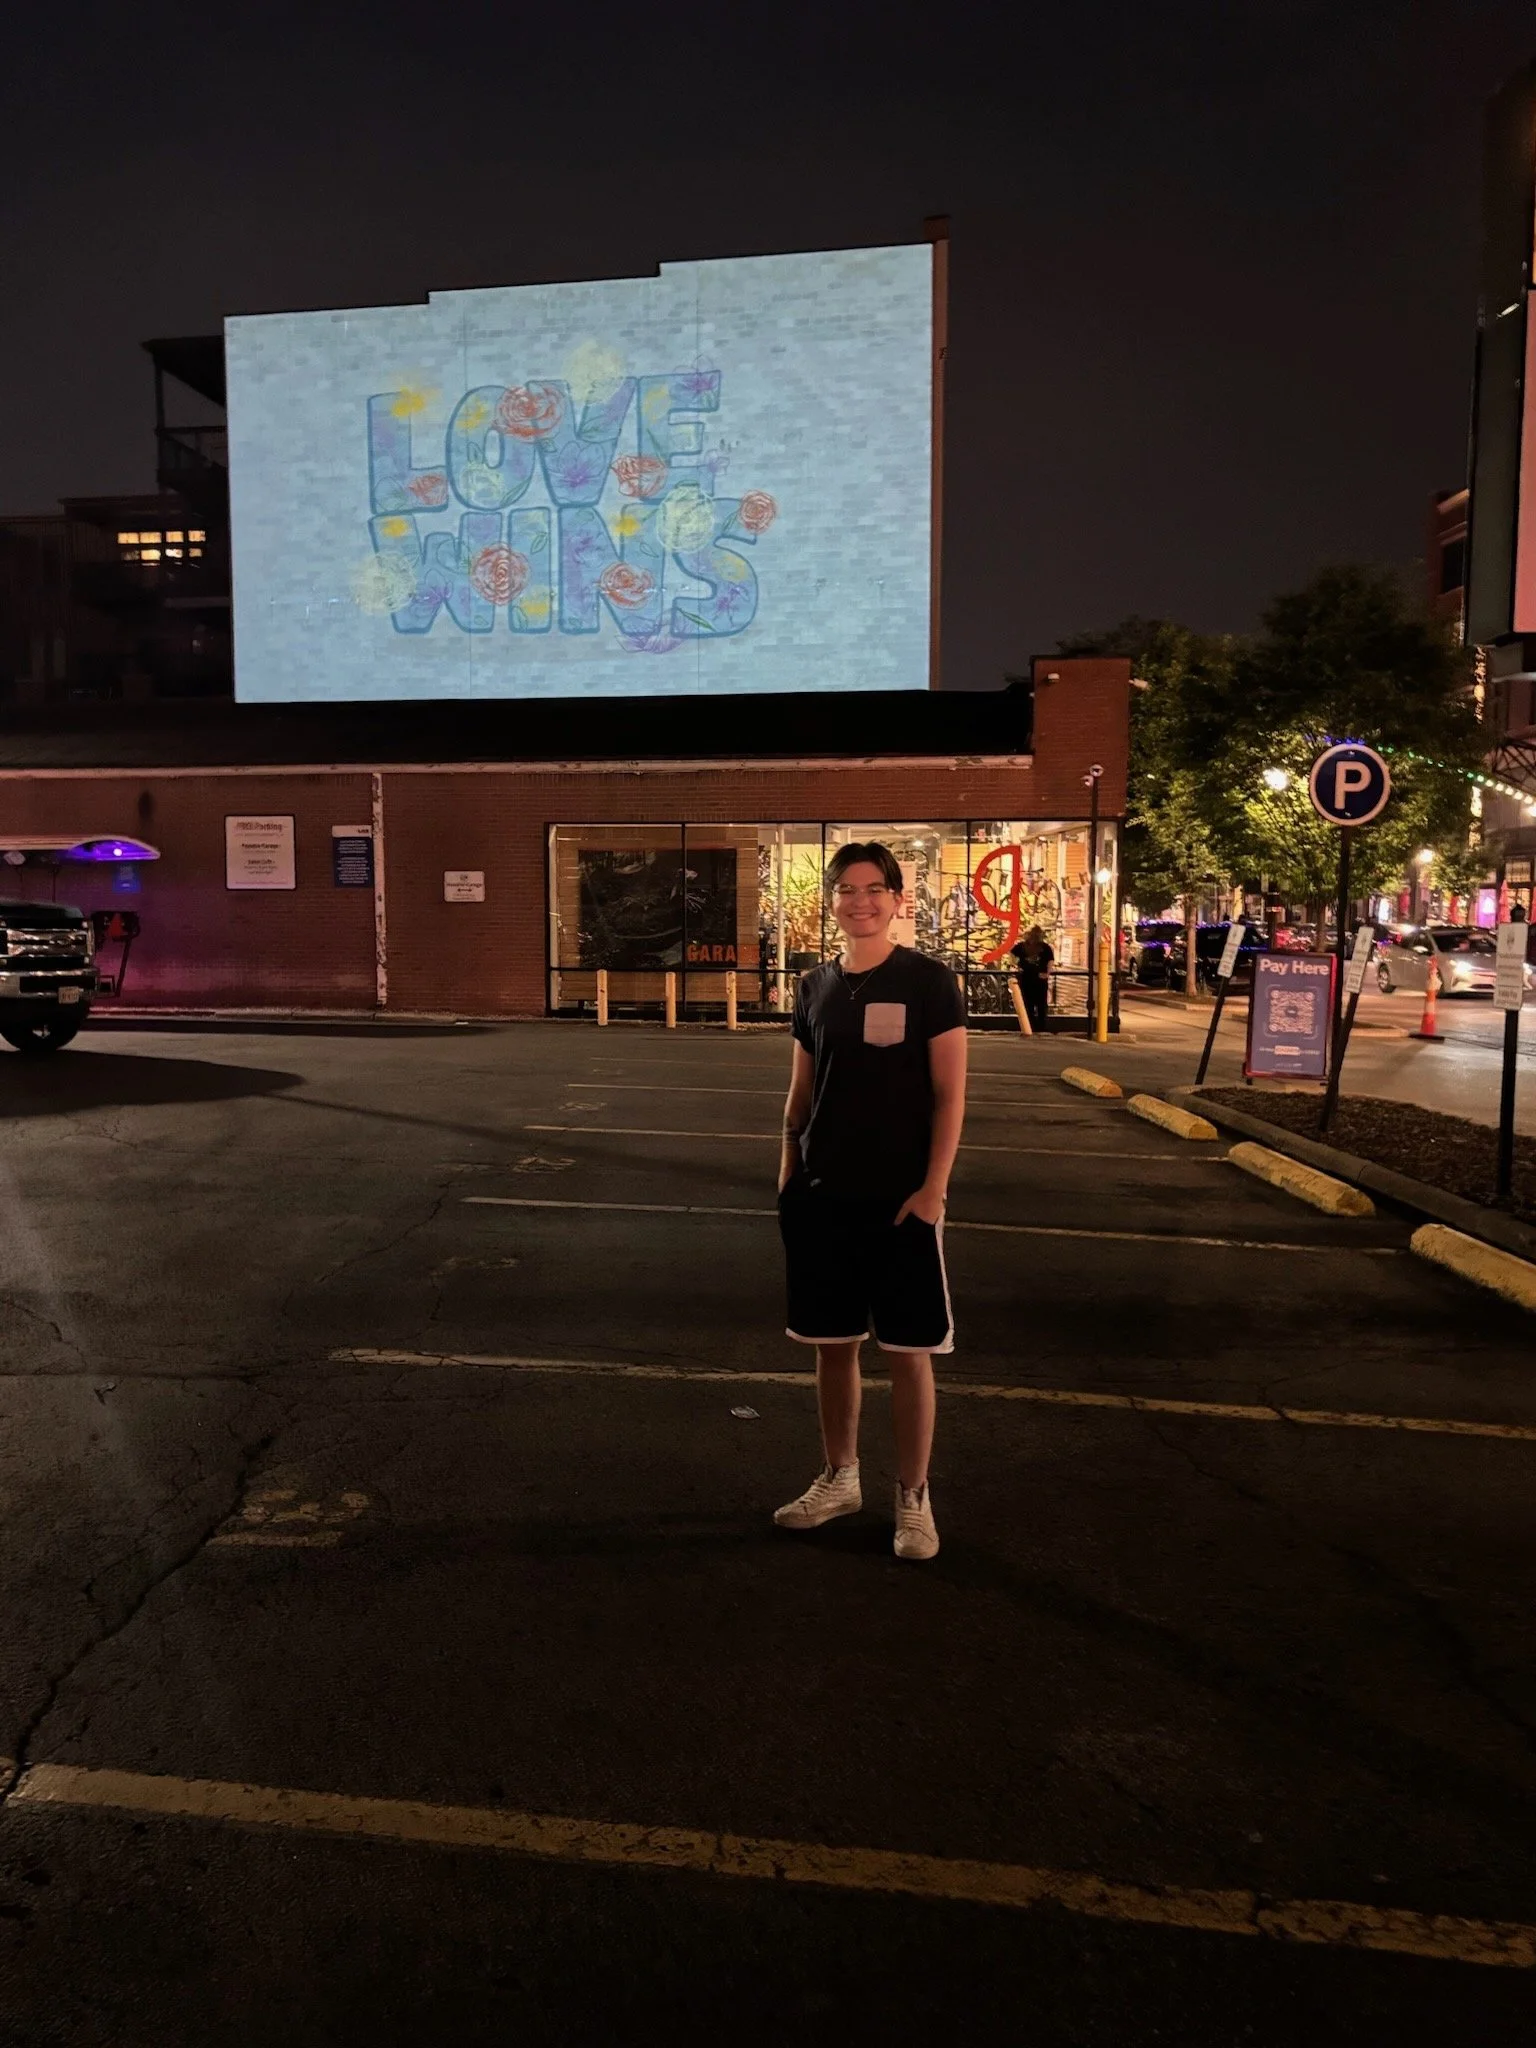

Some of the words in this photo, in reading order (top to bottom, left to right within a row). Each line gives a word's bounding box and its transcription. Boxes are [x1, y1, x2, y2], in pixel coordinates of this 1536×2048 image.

[366, 370, 722, 515] LOVE
[367, 497, 758, 639] WINS
[1334, 760, 1372, 809] P
[686, 943, 760, 963] GARA
[1259, 958, 1289, 976] Pay
[1291, 960, 1329, 976] Here
